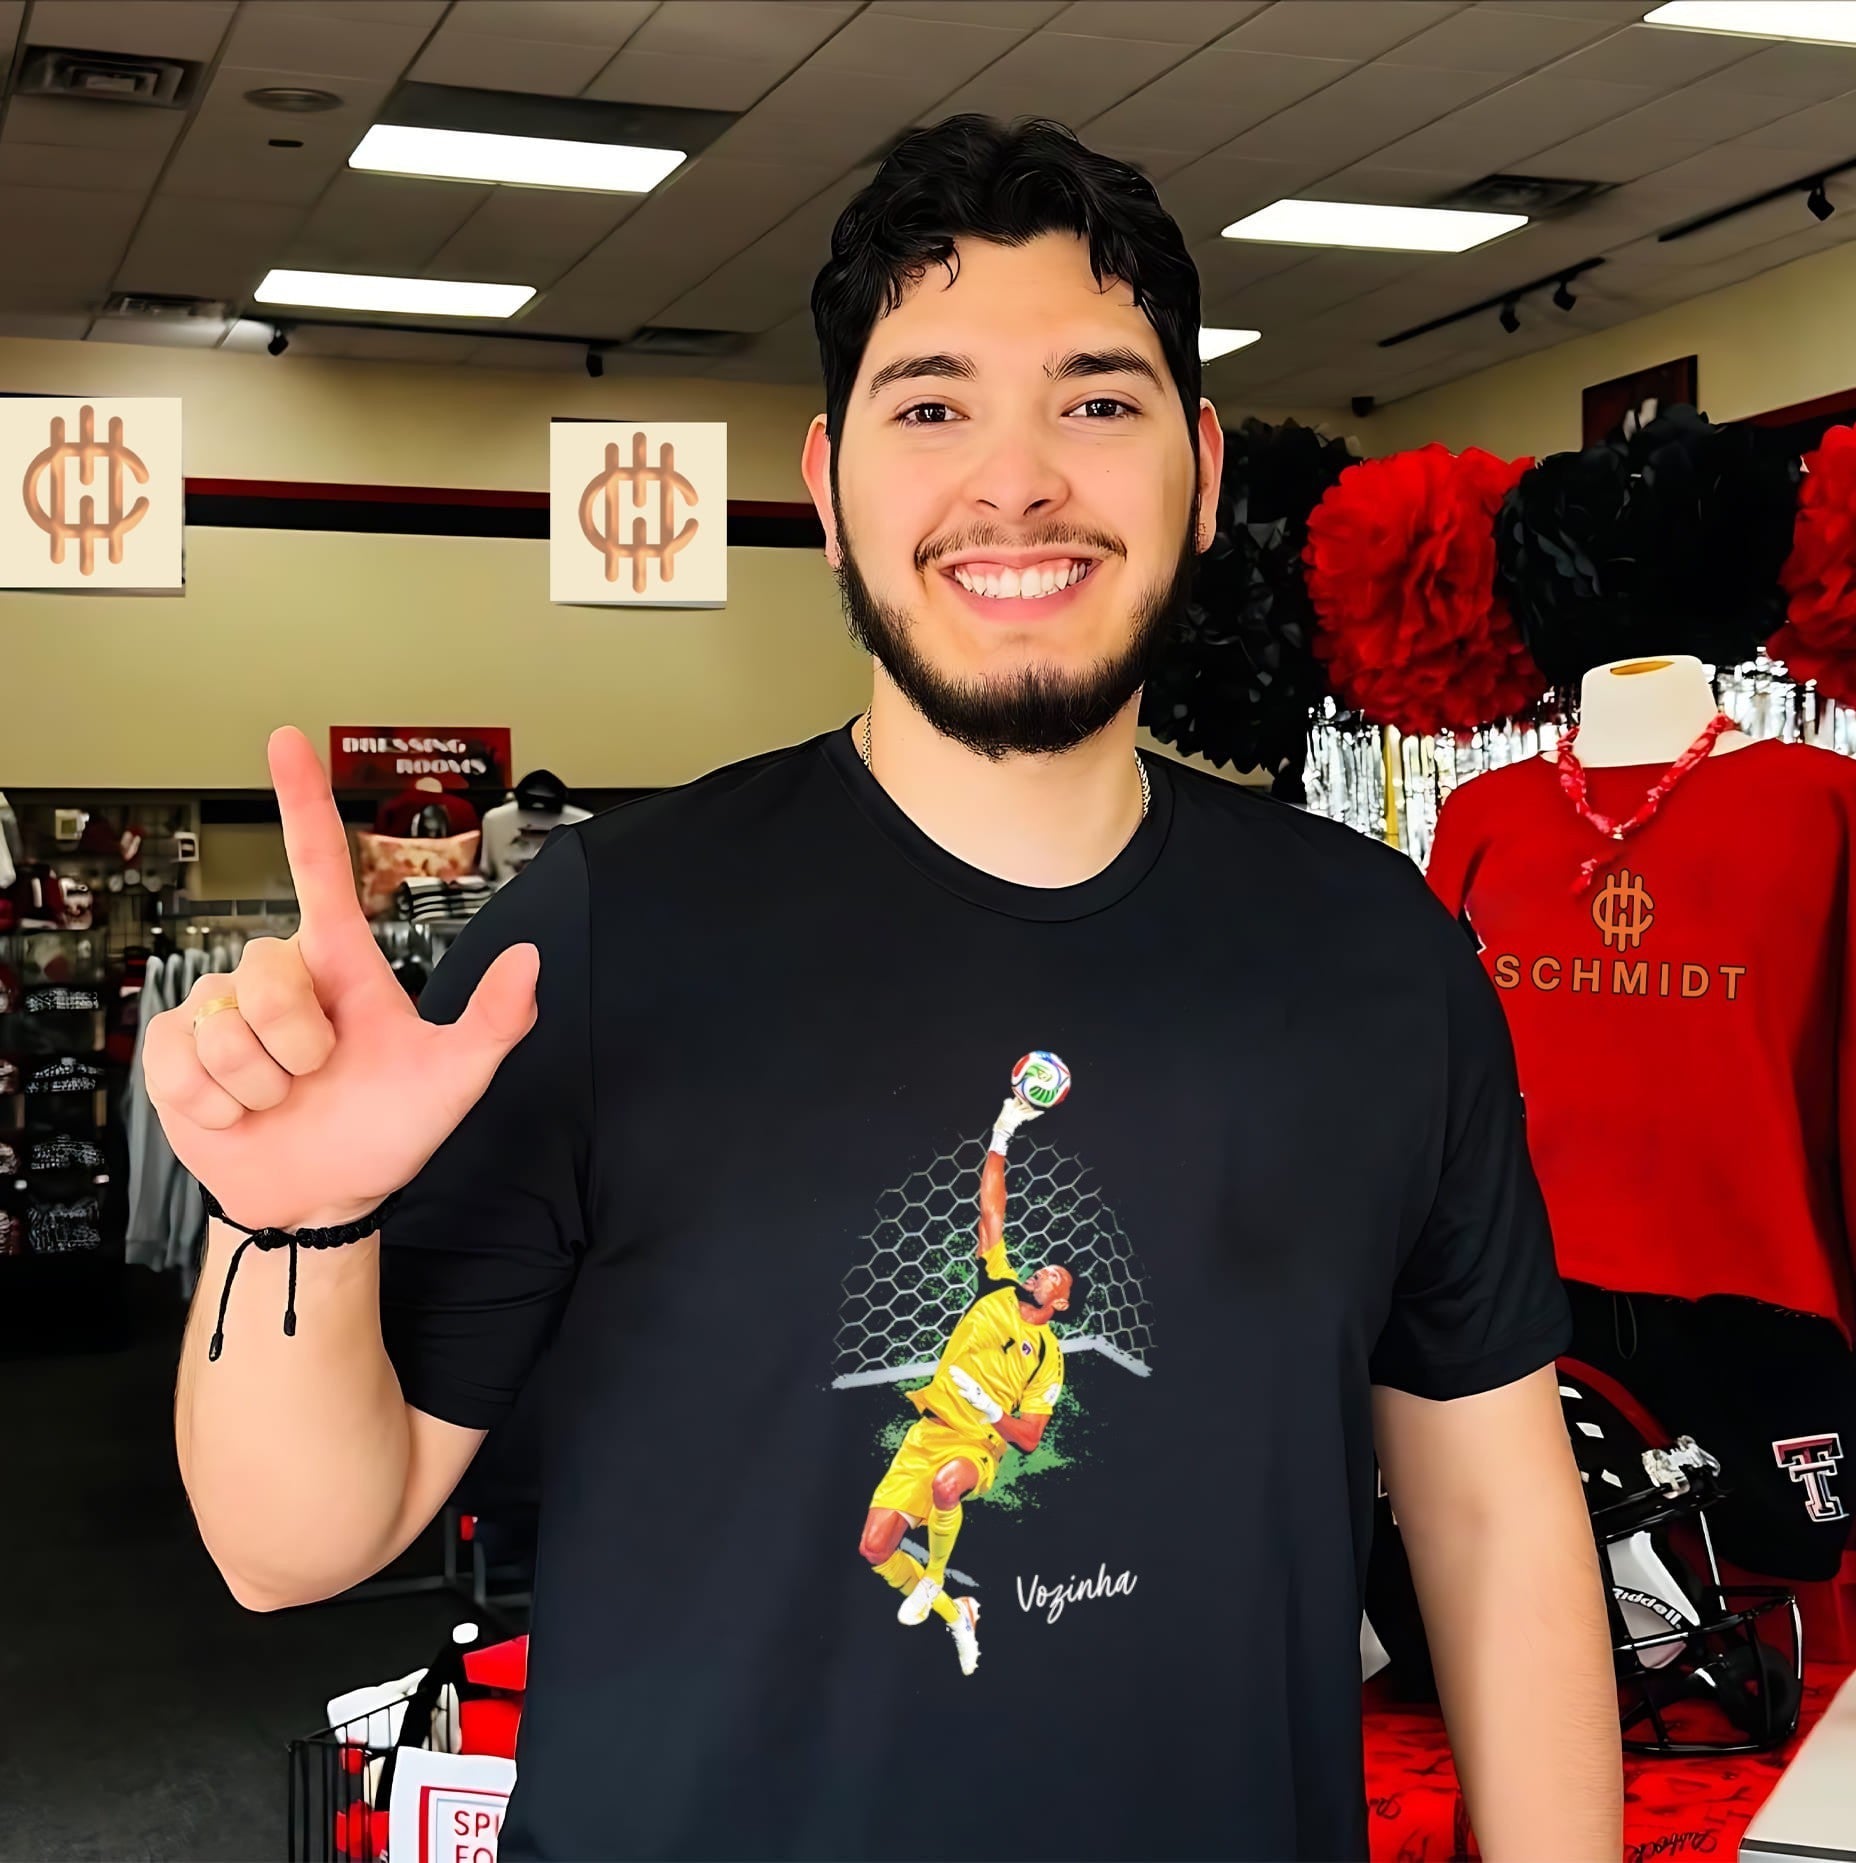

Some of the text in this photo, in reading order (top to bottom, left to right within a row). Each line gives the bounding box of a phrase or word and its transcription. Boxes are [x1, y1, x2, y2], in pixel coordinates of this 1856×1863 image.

[342, 737, 467, 754] DRESSING
[396, 758, 487, 775] ROOMS
[1494, 954, 1747, 1001] SCHMIDT
[1016, 1562, 1138, 1624] Vozinha
